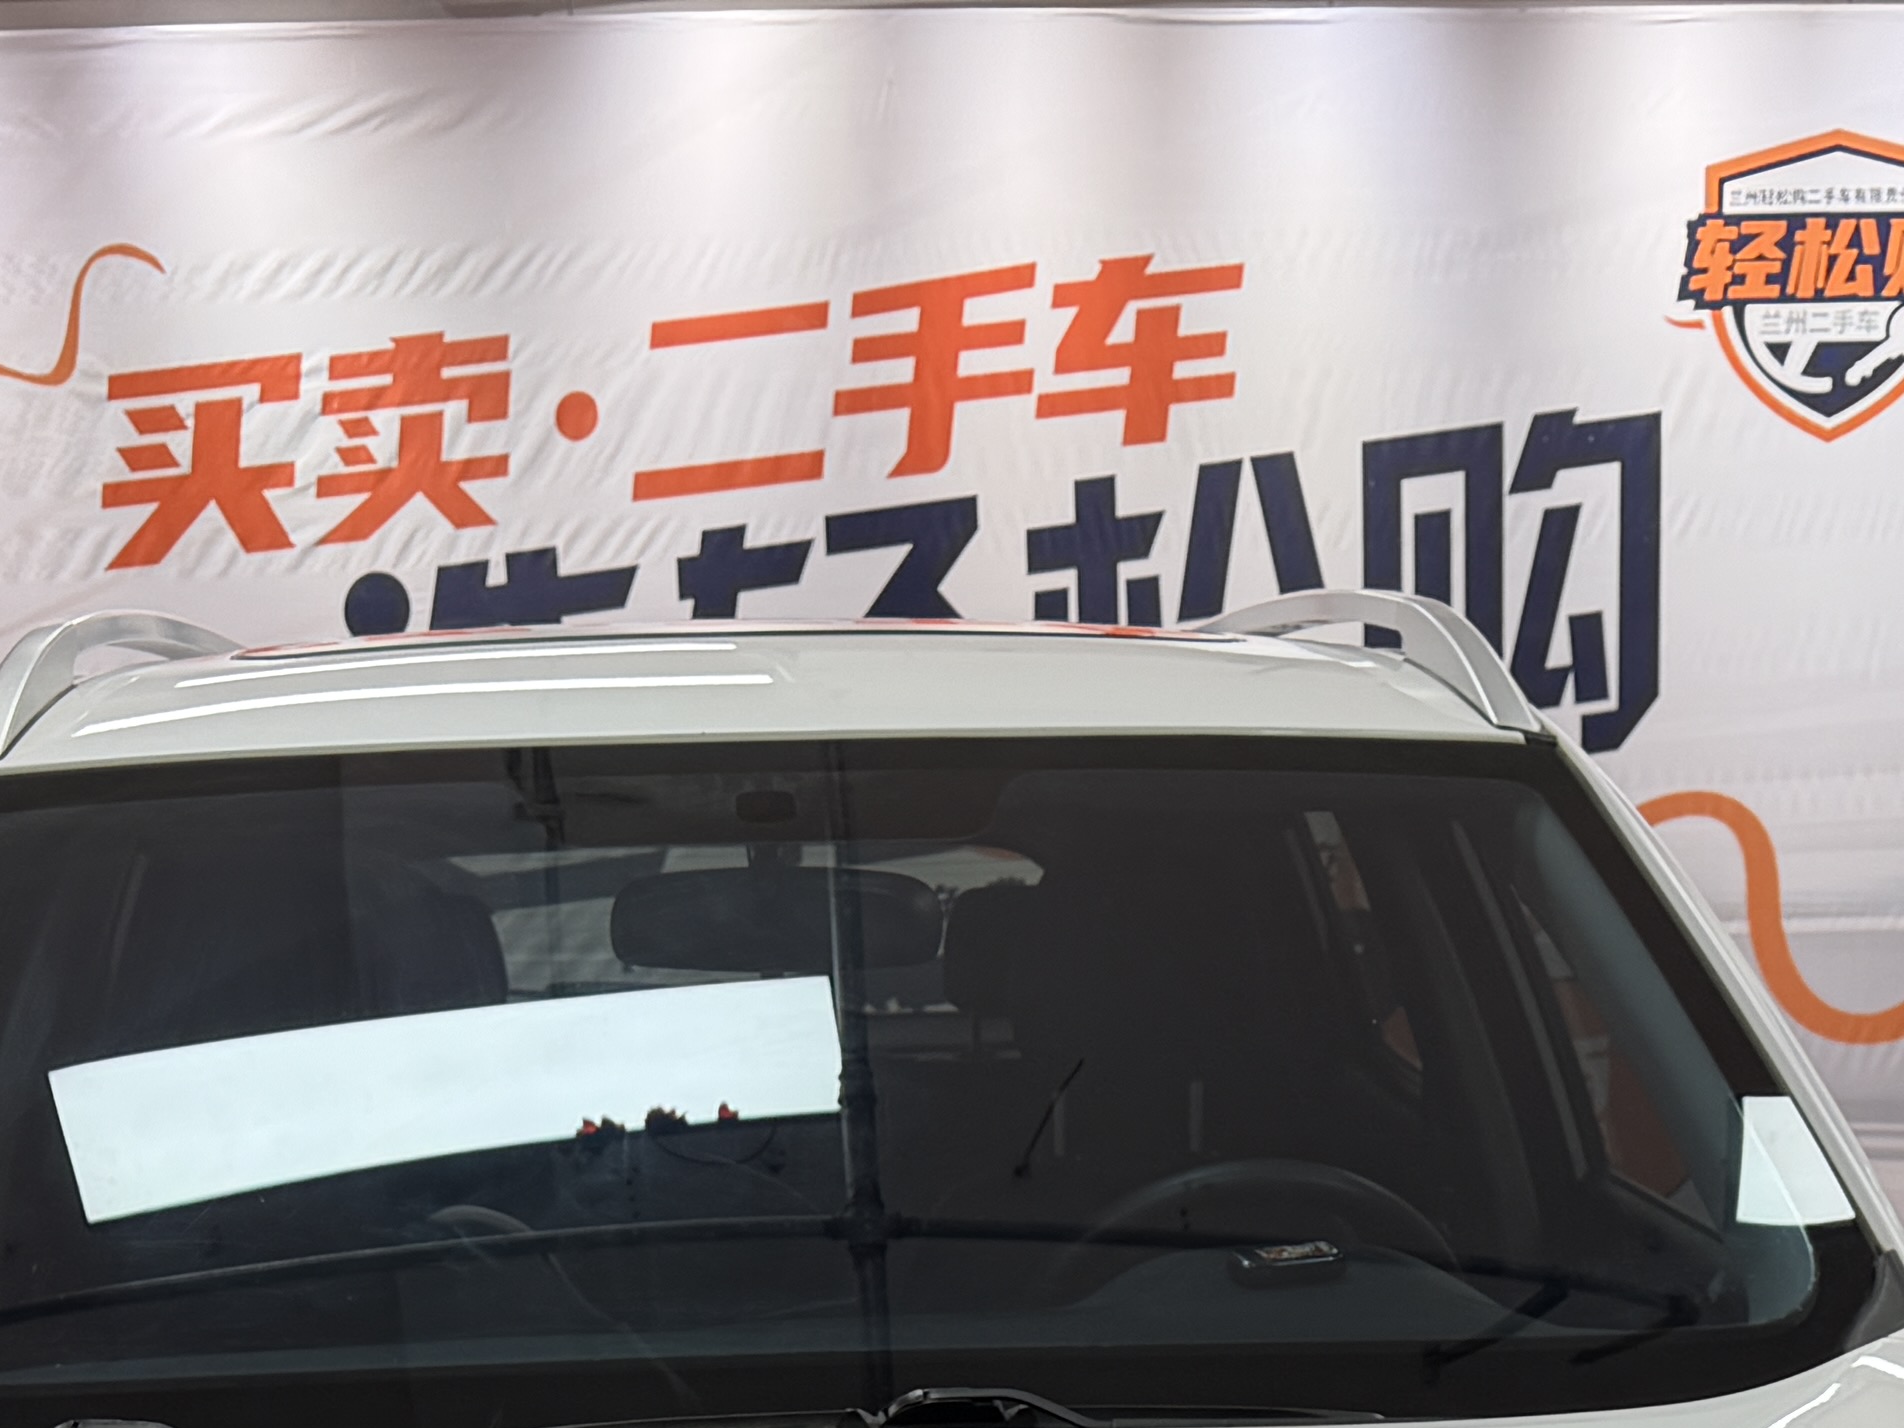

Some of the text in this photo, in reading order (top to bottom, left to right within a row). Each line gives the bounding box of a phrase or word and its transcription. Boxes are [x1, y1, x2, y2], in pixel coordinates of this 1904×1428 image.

[1757, 309, 1881, 336] 兰州二手车
